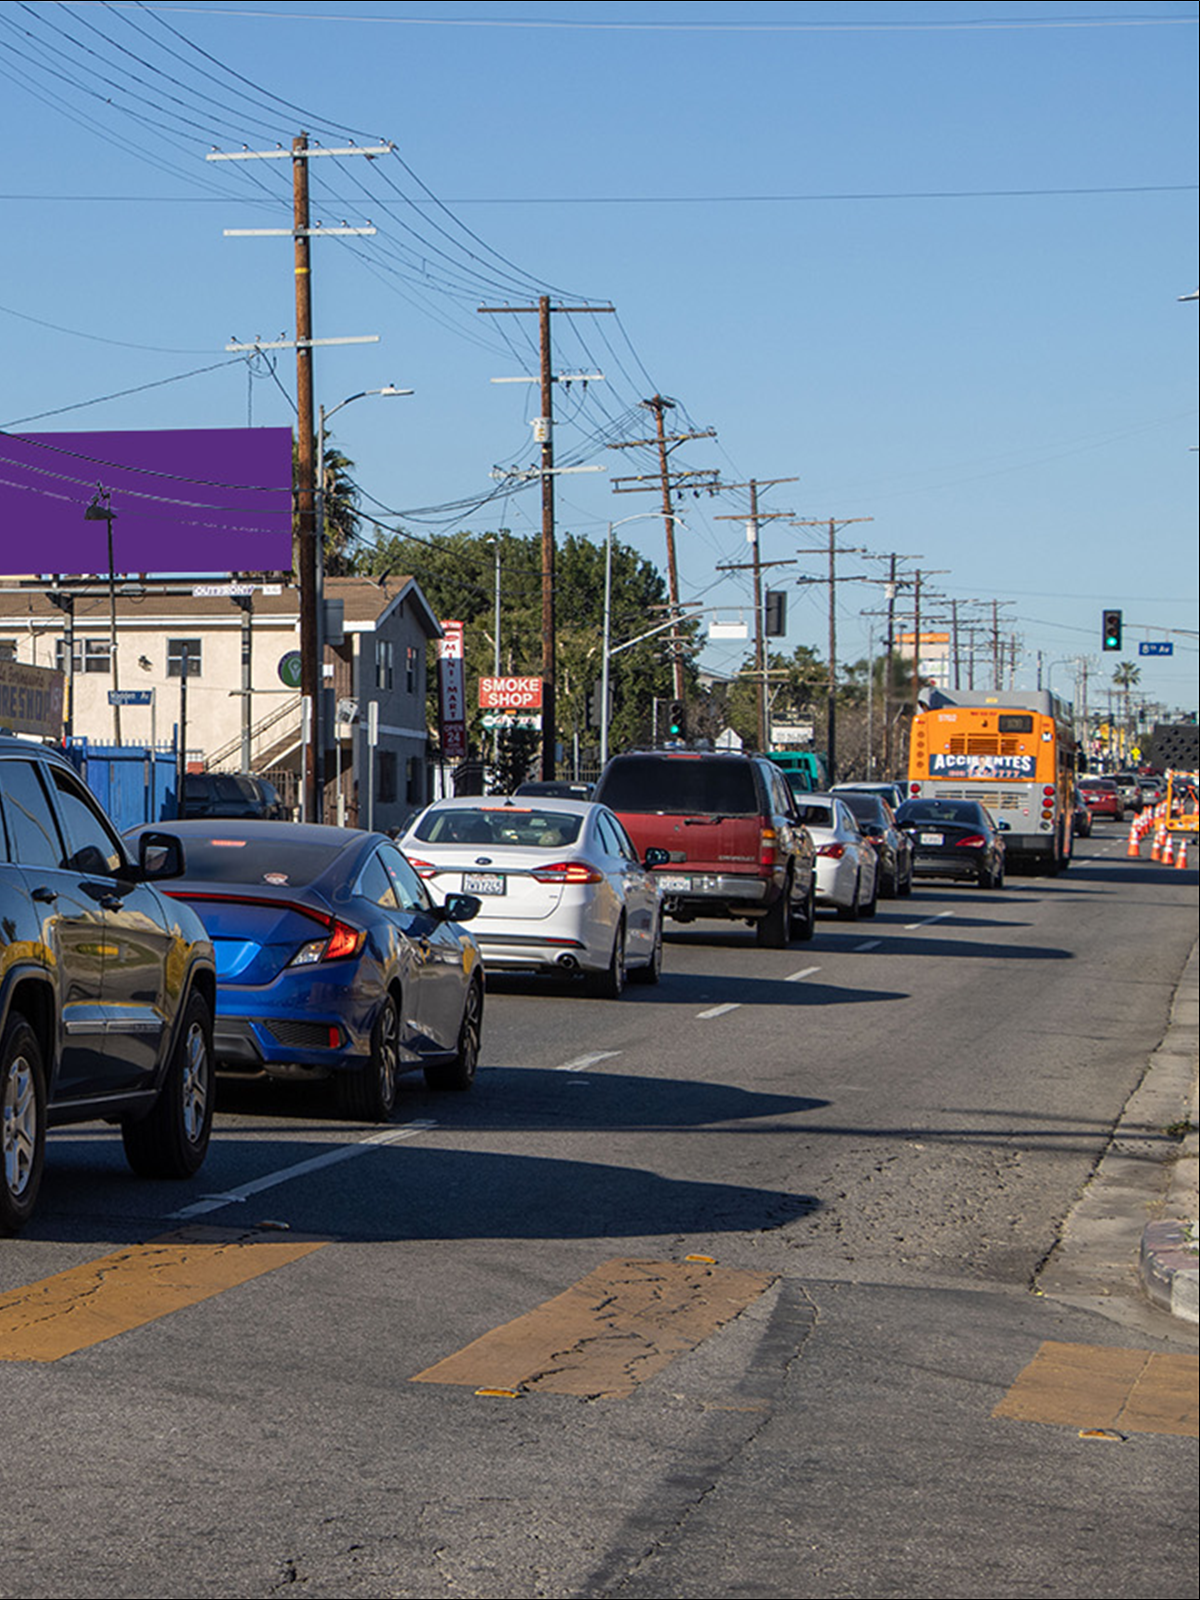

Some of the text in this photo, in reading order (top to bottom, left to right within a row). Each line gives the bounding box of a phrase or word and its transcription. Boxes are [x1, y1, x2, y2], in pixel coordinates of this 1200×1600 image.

[482, 679, 539, 692] SMOKE
[488, 693, 533, 706] SHOP
[447, 731, 460, 742] 24
